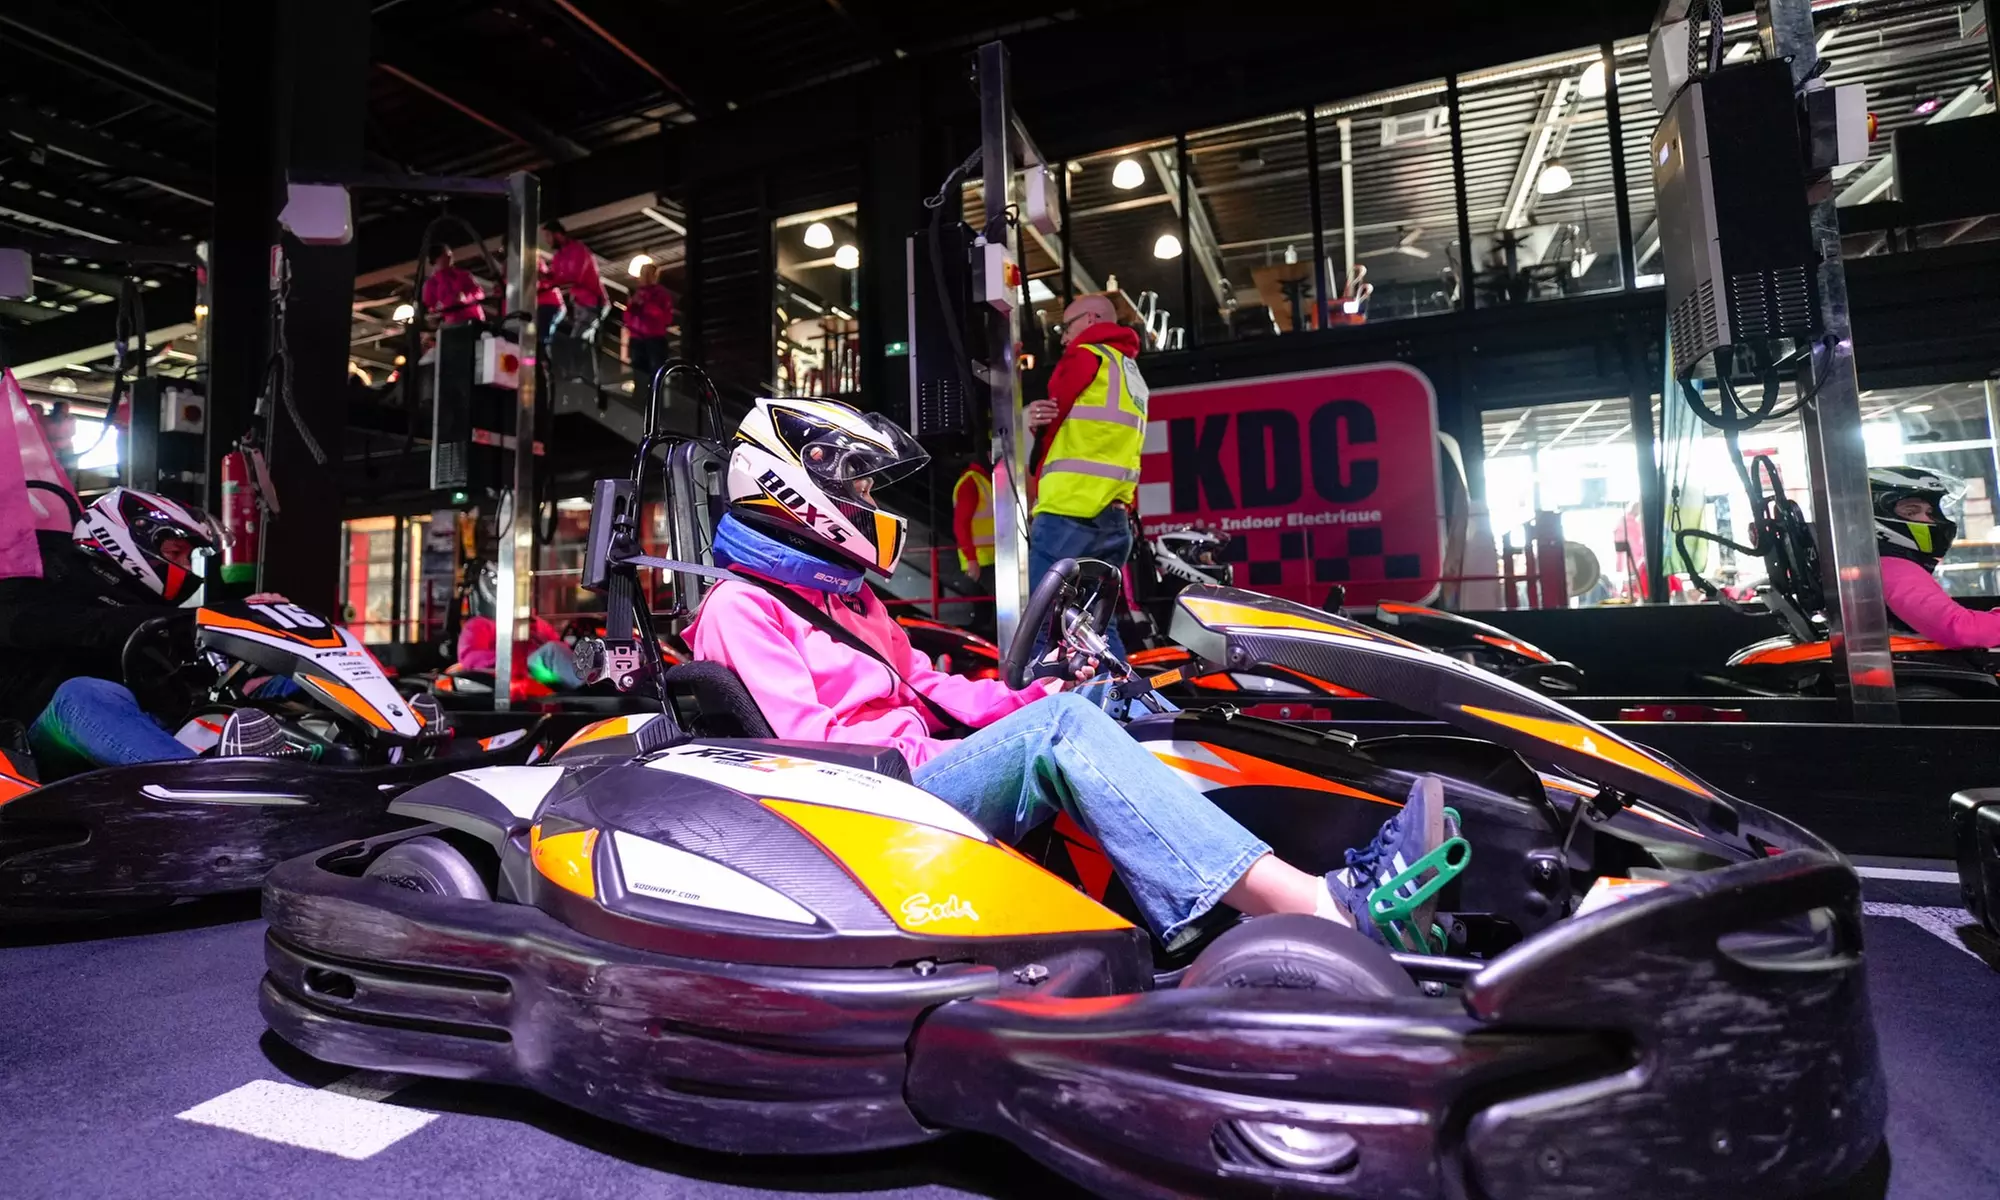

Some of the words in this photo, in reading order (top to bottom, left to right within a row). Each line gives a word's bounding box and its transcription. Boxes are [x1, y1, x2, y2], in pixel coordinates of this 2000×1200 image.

[1170, 398, 1379, 513] KDC
[757, 468, 854, 544] BOX'S
[1221, 515, 1282, 531] Indoor
[93, 526, 150, 581] BOX'S
[248, 603, 326, 629] 16
[632, 882, 701, 901] SODIKART.COM
